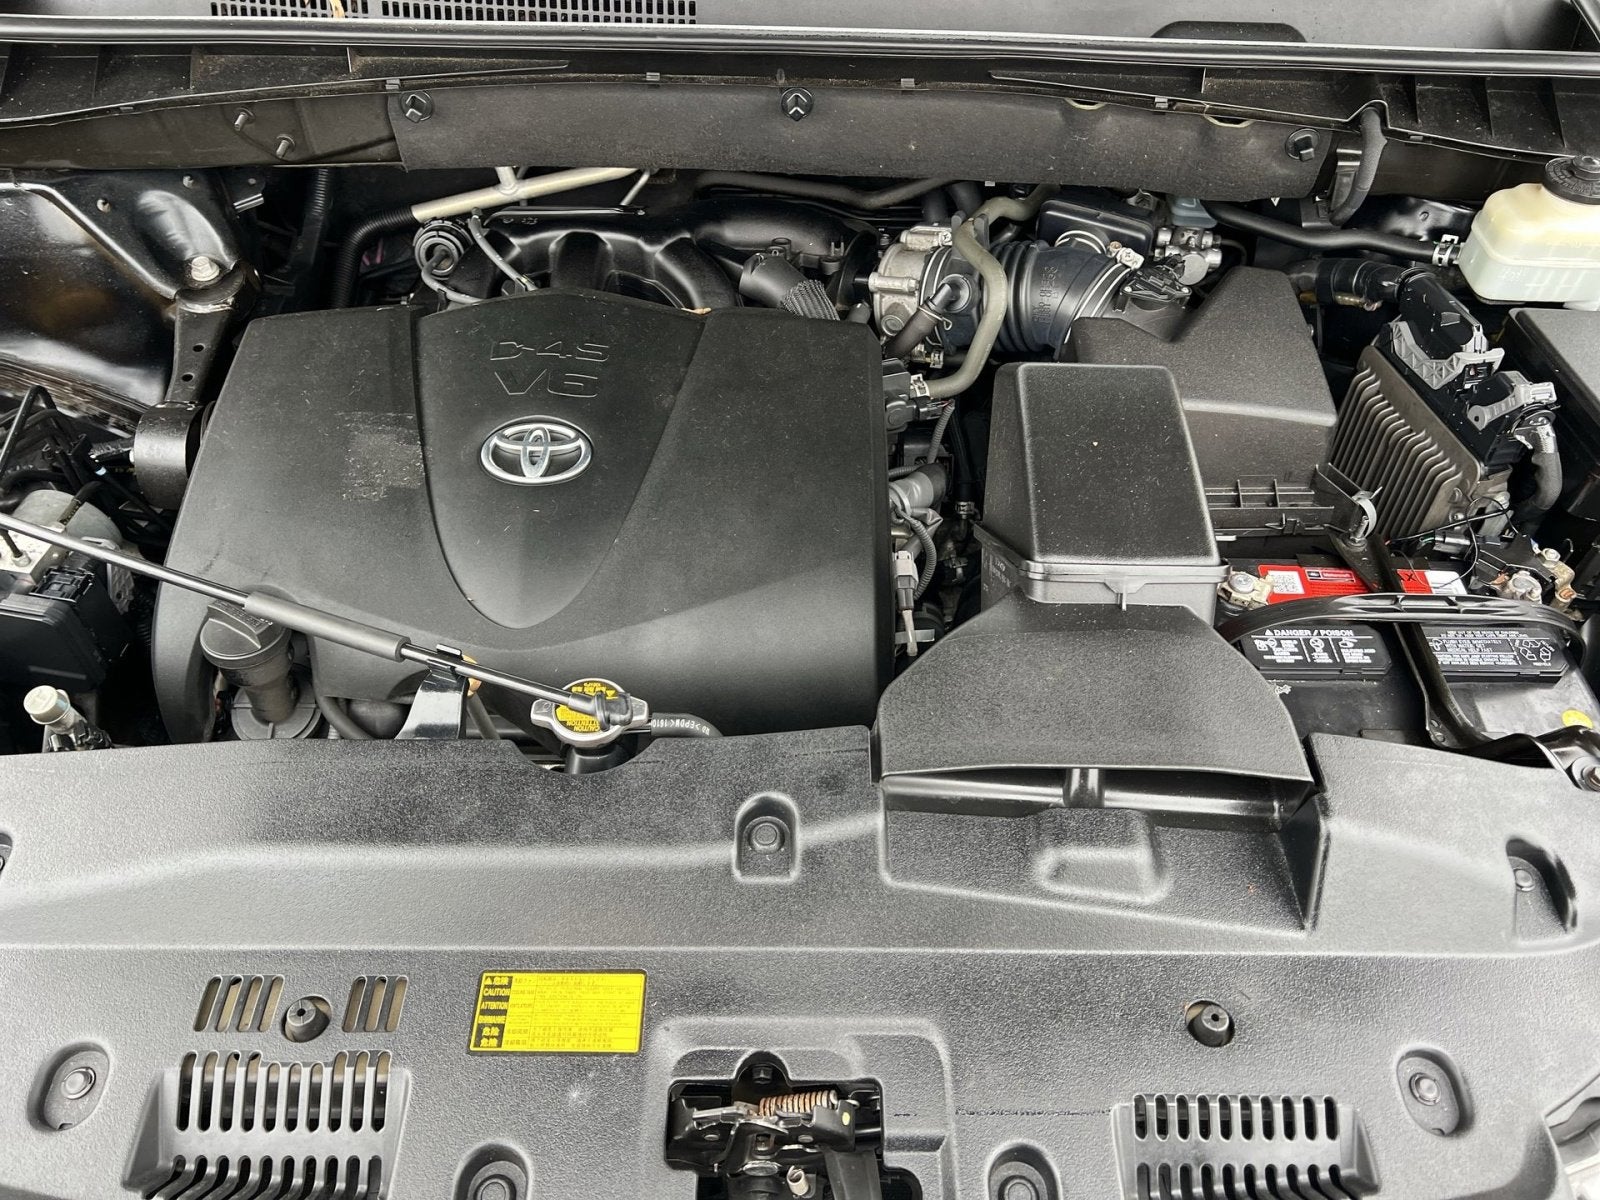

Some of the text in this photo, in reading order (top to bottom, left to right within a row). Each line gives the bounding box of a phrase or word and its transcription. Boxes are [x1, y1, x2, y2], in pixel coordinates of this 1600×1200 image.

[494, 368, 598, 398] V6
[1273, 629, 1312, 637] DANGER
[1320, 629, 1354, 637] POISON
[483, 988, 511, 996] CAUTION
[480, 1001, 509, 1010] ATTENTION
